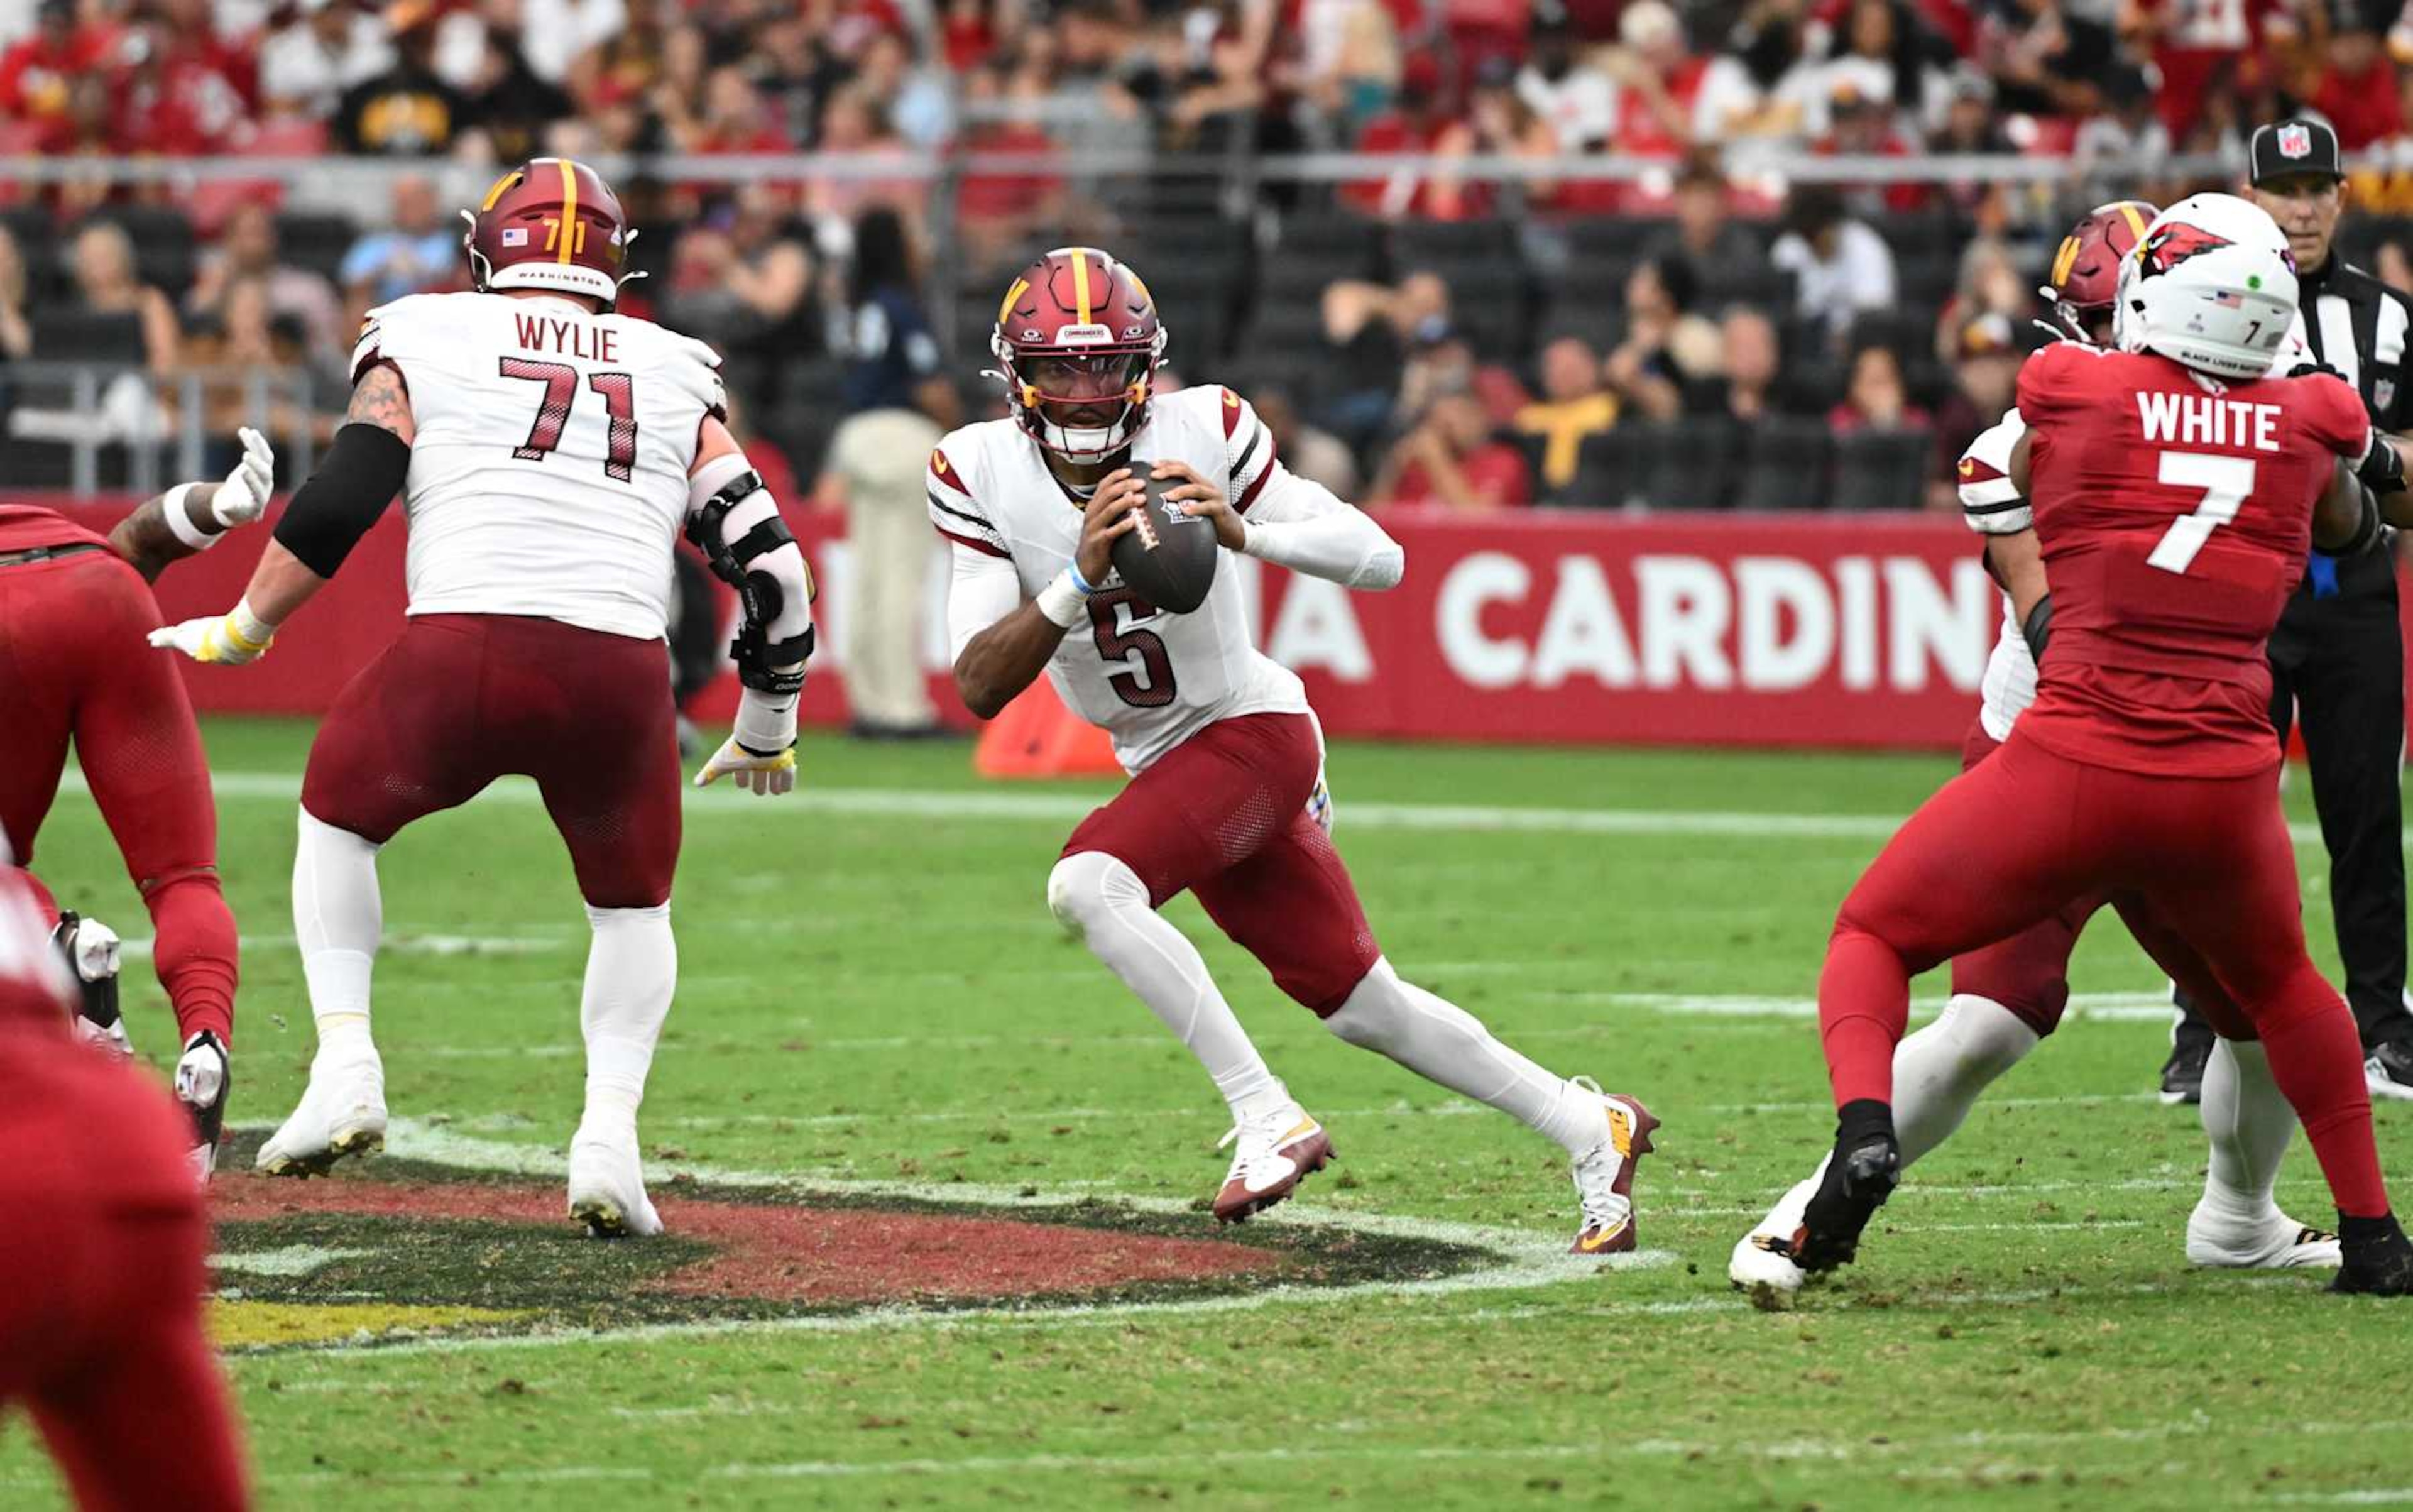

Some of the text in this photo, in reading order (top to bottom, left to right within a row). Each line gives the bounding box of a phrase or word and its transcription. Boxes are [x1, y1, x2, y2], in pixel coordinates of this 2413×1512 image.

[542, 217, 586, 254] 71
[518, 271, 601, 287] WASHINGTON
[515, 313, 619, 364] WYLIE
[2243, 320, 2261, 344] 7
[499, 356, 638, 483] 71
[2137, 391, 2282, 452] WHITE
[2146, 451, 2256, 574] 7
[1086, 586, 1177, 708] 5
